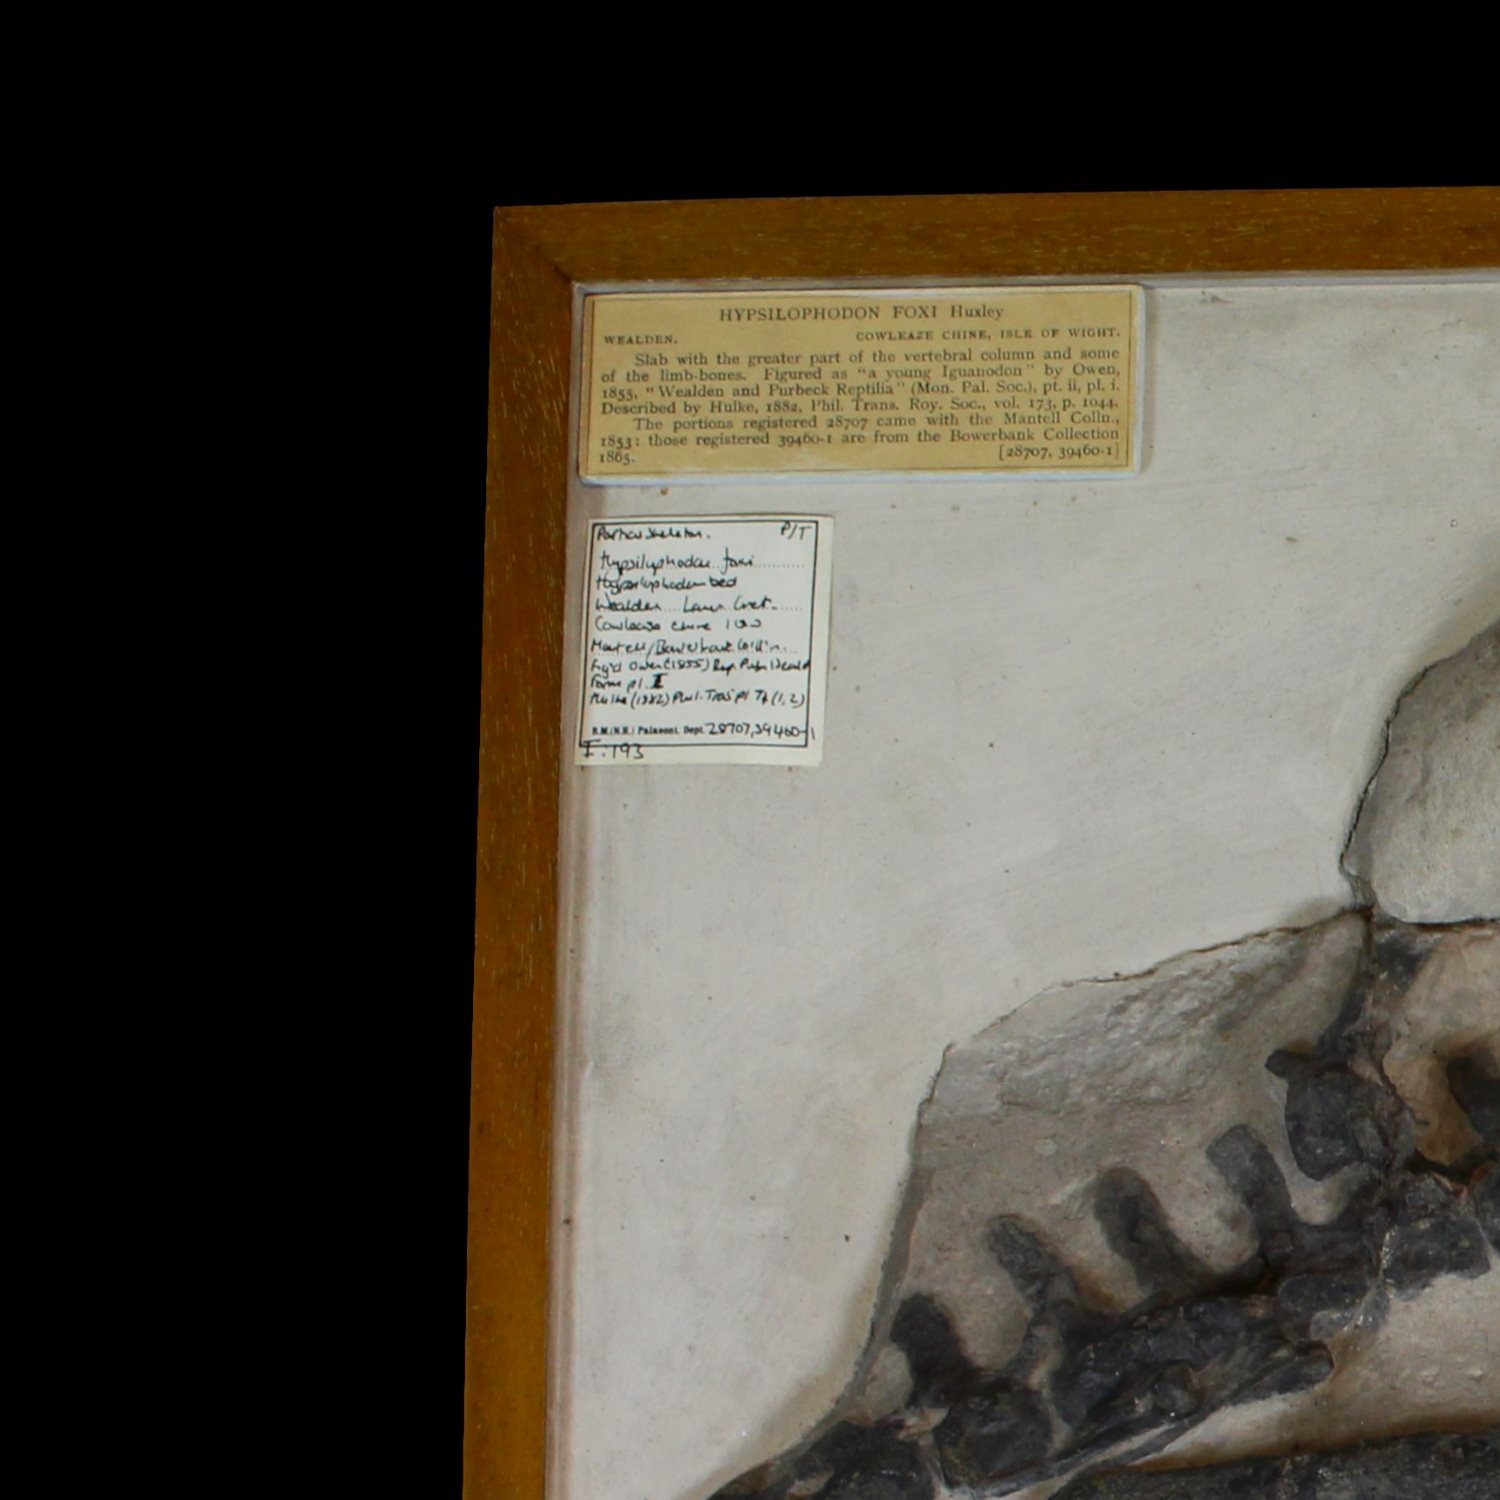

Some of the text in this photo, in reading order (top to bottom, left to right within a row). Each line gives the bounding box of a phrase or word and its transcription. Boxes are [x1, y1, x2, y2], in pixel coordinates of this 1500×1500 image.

[720, 304, 1004, 322] HYPSILOPHODON FOXI Huxley
[604, 335, 678, 345] WEALDEN.
[1001, 329, 1032, 339] ISLE
[1041, 328, 1060, 338] OF
[1068, 328, 1120, 338] WIGHT.
[634, 346, 1119, 368] Slab with the greater part of the vertebral column and some
[601, 369, 616, 383] of
[626, 369, 649, 383] the
[763, 366, 822, 384] Figured
[832, 370, 847, 379] as
[885, 368, 931, 381] young
[1044, 363, 1062, 379] by
[1072, 363, 1120, 377] Owen,
[732, 384, 760, 397] and
[768, 383, 829, 396] Purbeck
[911, 381, 954, 396] (Mon.
[962, 380, 990, 393] Pal.
[1043, 378, 1062, 396] pt.
[1068, 378, 1081, 394] ii,
[1087, 378, 1104, 395] pl.
[1112, 378, 1120, 391] i.
[601, 401, 676, 415] Described
[683, 401, 701, 417] by
[710, 400, 758, 414] Hulke,
[811, 398, 844, 412] Phil.
[852, 398, 899, 412] Trans.
[910, 397, 942, 414] Roy.
[994, 396, 1020, 409] vol.
[1062, 398, 1076, 412] p.
[1082, 398, 1118, 410] 1044.
[633, 417, 663, 430] The
[673, 416, 733, 434] portions
[744, 415, 817, 432] registered
[826, 415, 868, 431] 28707
[876, 416, 916, 427] came
[926, 413, 959, 426] with
[970, 412, 992, 426] the
[1004, 410, 1060, 424] Mantell
[648, 434, 687, 446] those
[696, 431, 770, 449] registered
[778, 432, 832, 448] 39460-1
[841, 434, 866, 444] are
[874, 430, 909, 443] from
[918, 429, 941, 442] the
[950, 428, 1034, 442] Bowerbank
[1043, 426, 1118, 441] Collection
[600, 449, 635, 466] 1865.
